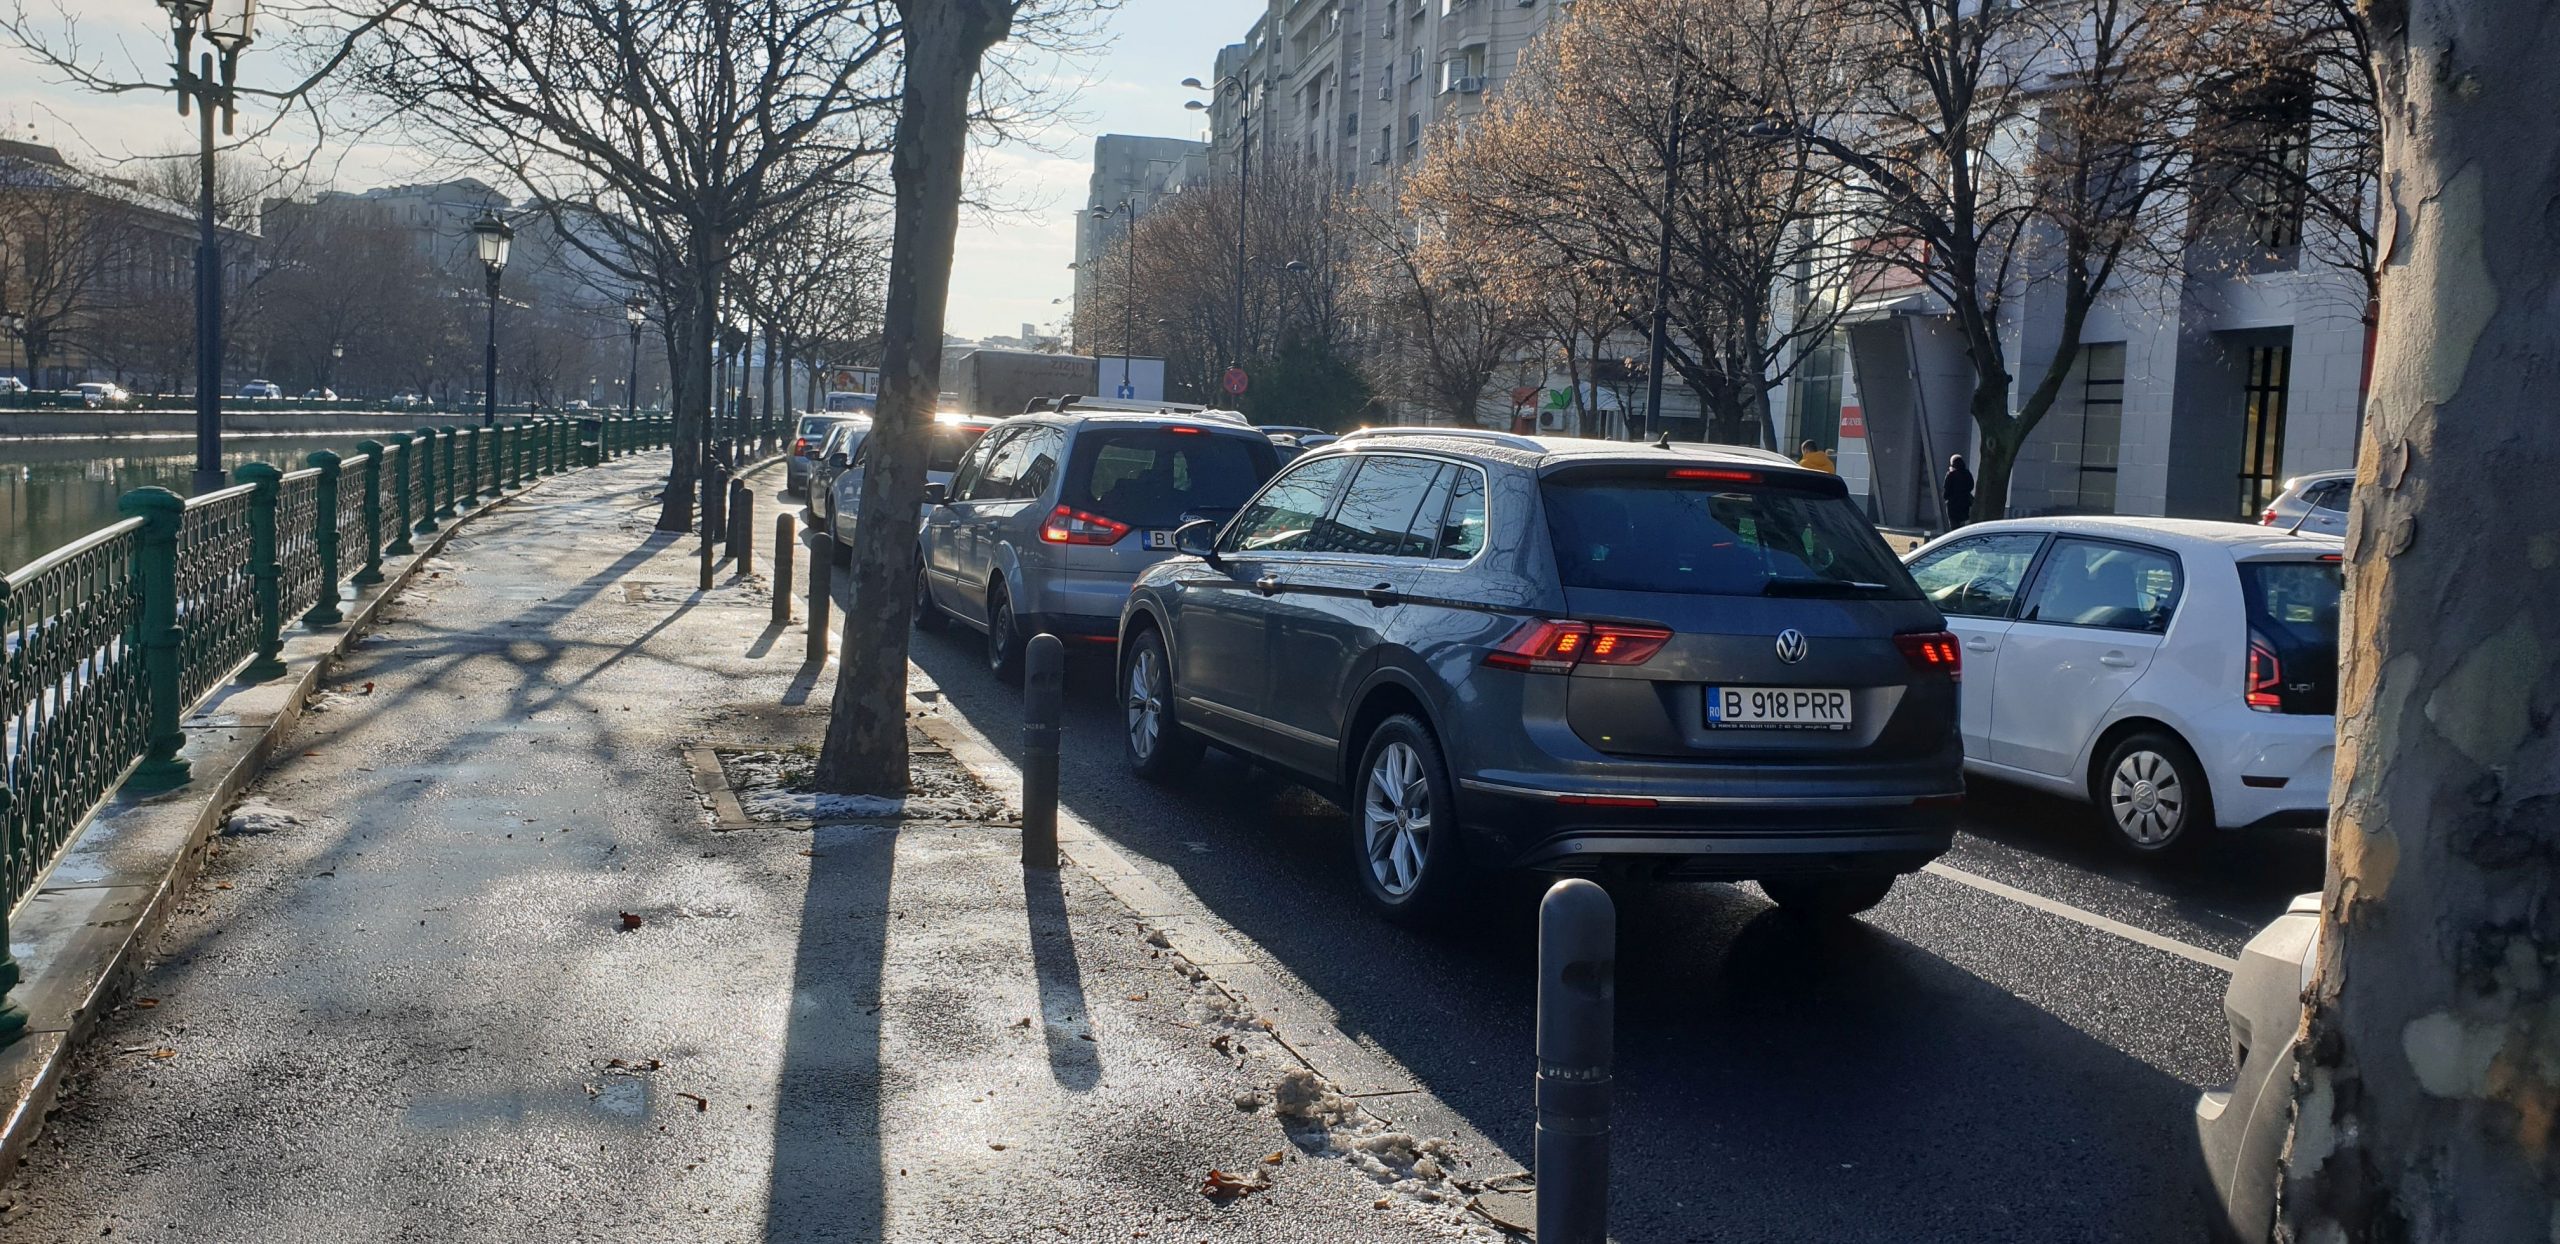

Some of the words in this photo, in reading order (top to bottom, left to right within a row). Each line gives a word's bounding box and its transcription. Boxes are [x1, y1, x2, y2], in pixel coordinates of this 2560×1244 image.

[1709, 706, 1720, 717] RO
[1725, 691, 1743, 718] B
[1752, 691, 1789, 719] 918
[1793, 692, 1845, 719] PRR
